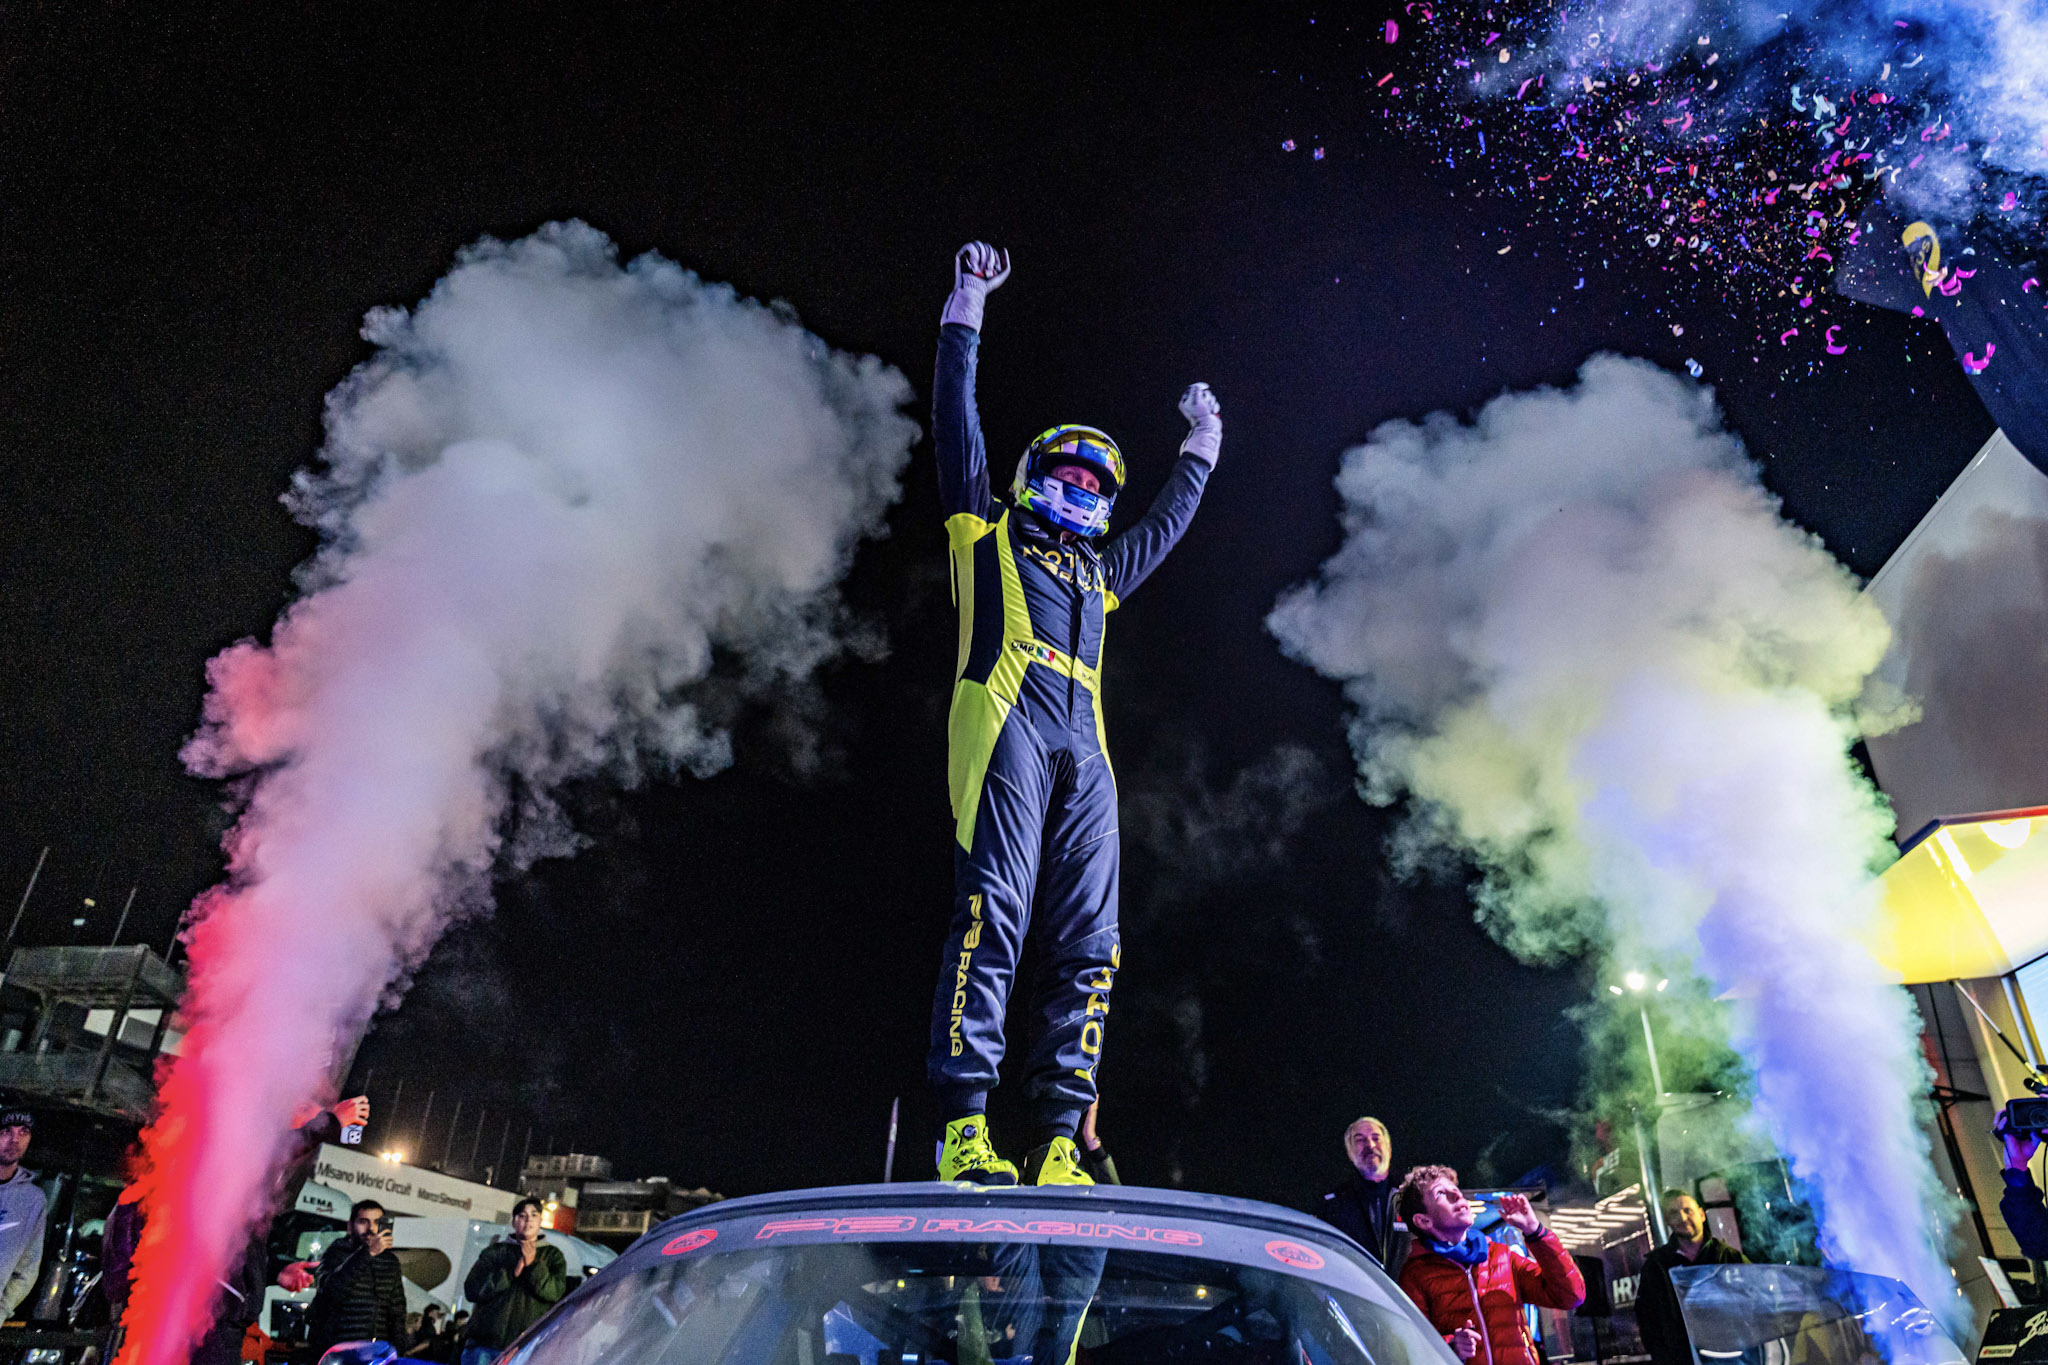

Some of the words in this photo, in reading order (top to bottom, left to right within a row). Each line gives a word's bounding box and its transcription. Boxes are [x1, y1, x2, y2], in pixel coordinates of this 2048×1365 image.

[963, 893, 984, 950] PB
[949, 951, 972, 1057] RACING
[317, 1162, 355, 1183] Misano
[356, 1170, 385, 1190] World
[385, 1177, 412, 1196] Circuit
[303, 1195, 333, 1208] LEMA
[922, 1219, 1203, 1247] RACING
